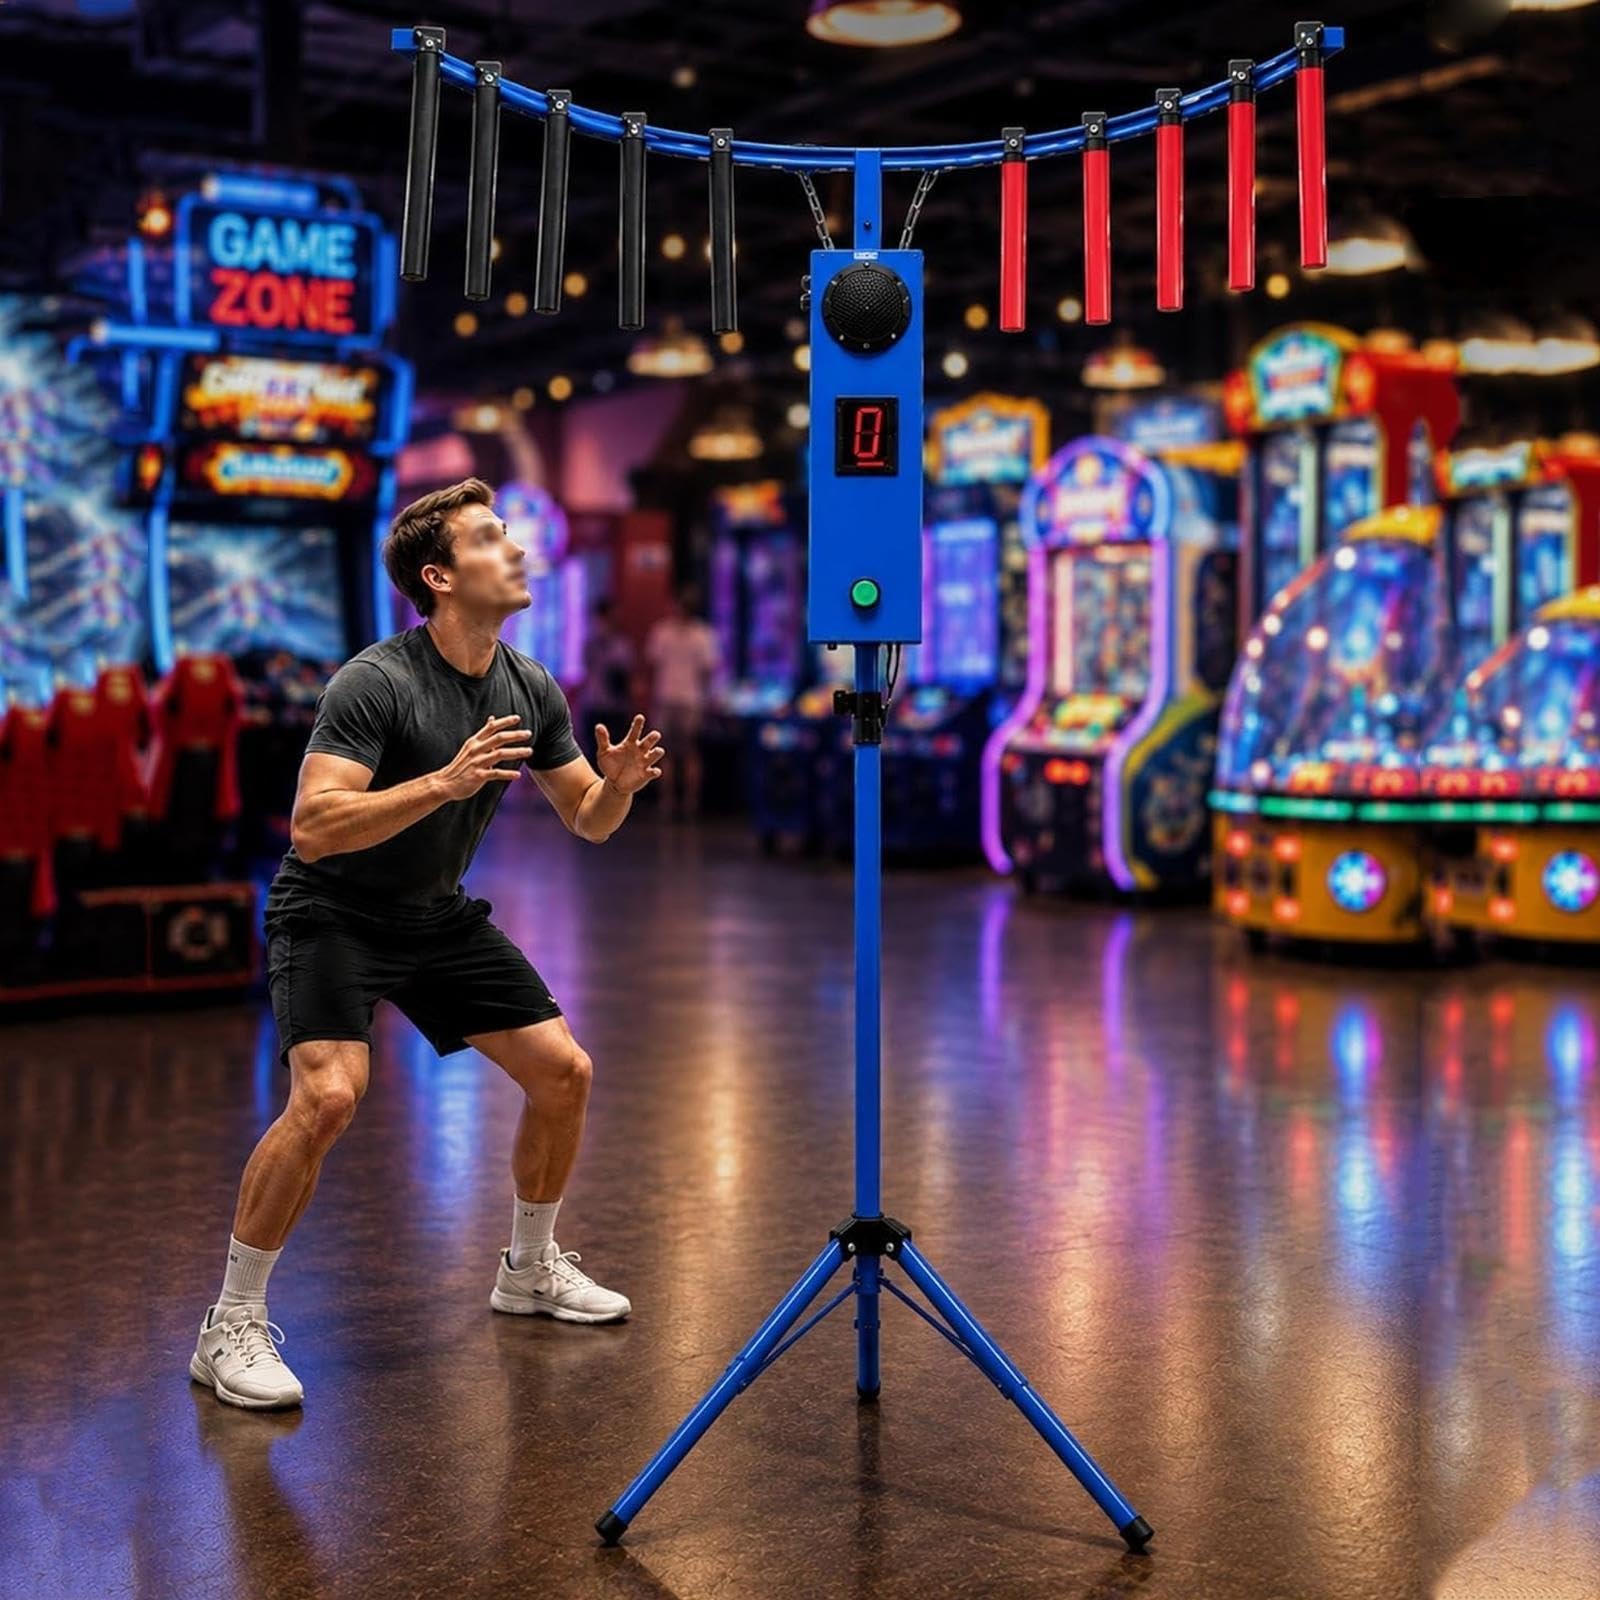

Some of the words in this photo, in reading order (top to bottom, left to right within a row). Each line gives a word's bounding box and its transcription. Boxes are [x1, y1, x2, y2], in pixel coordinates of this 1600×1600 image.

[209, 213, 356, 280] GAME
[210, 267, 355, 335] ZONE
[854, 407, 883, 459] 0
